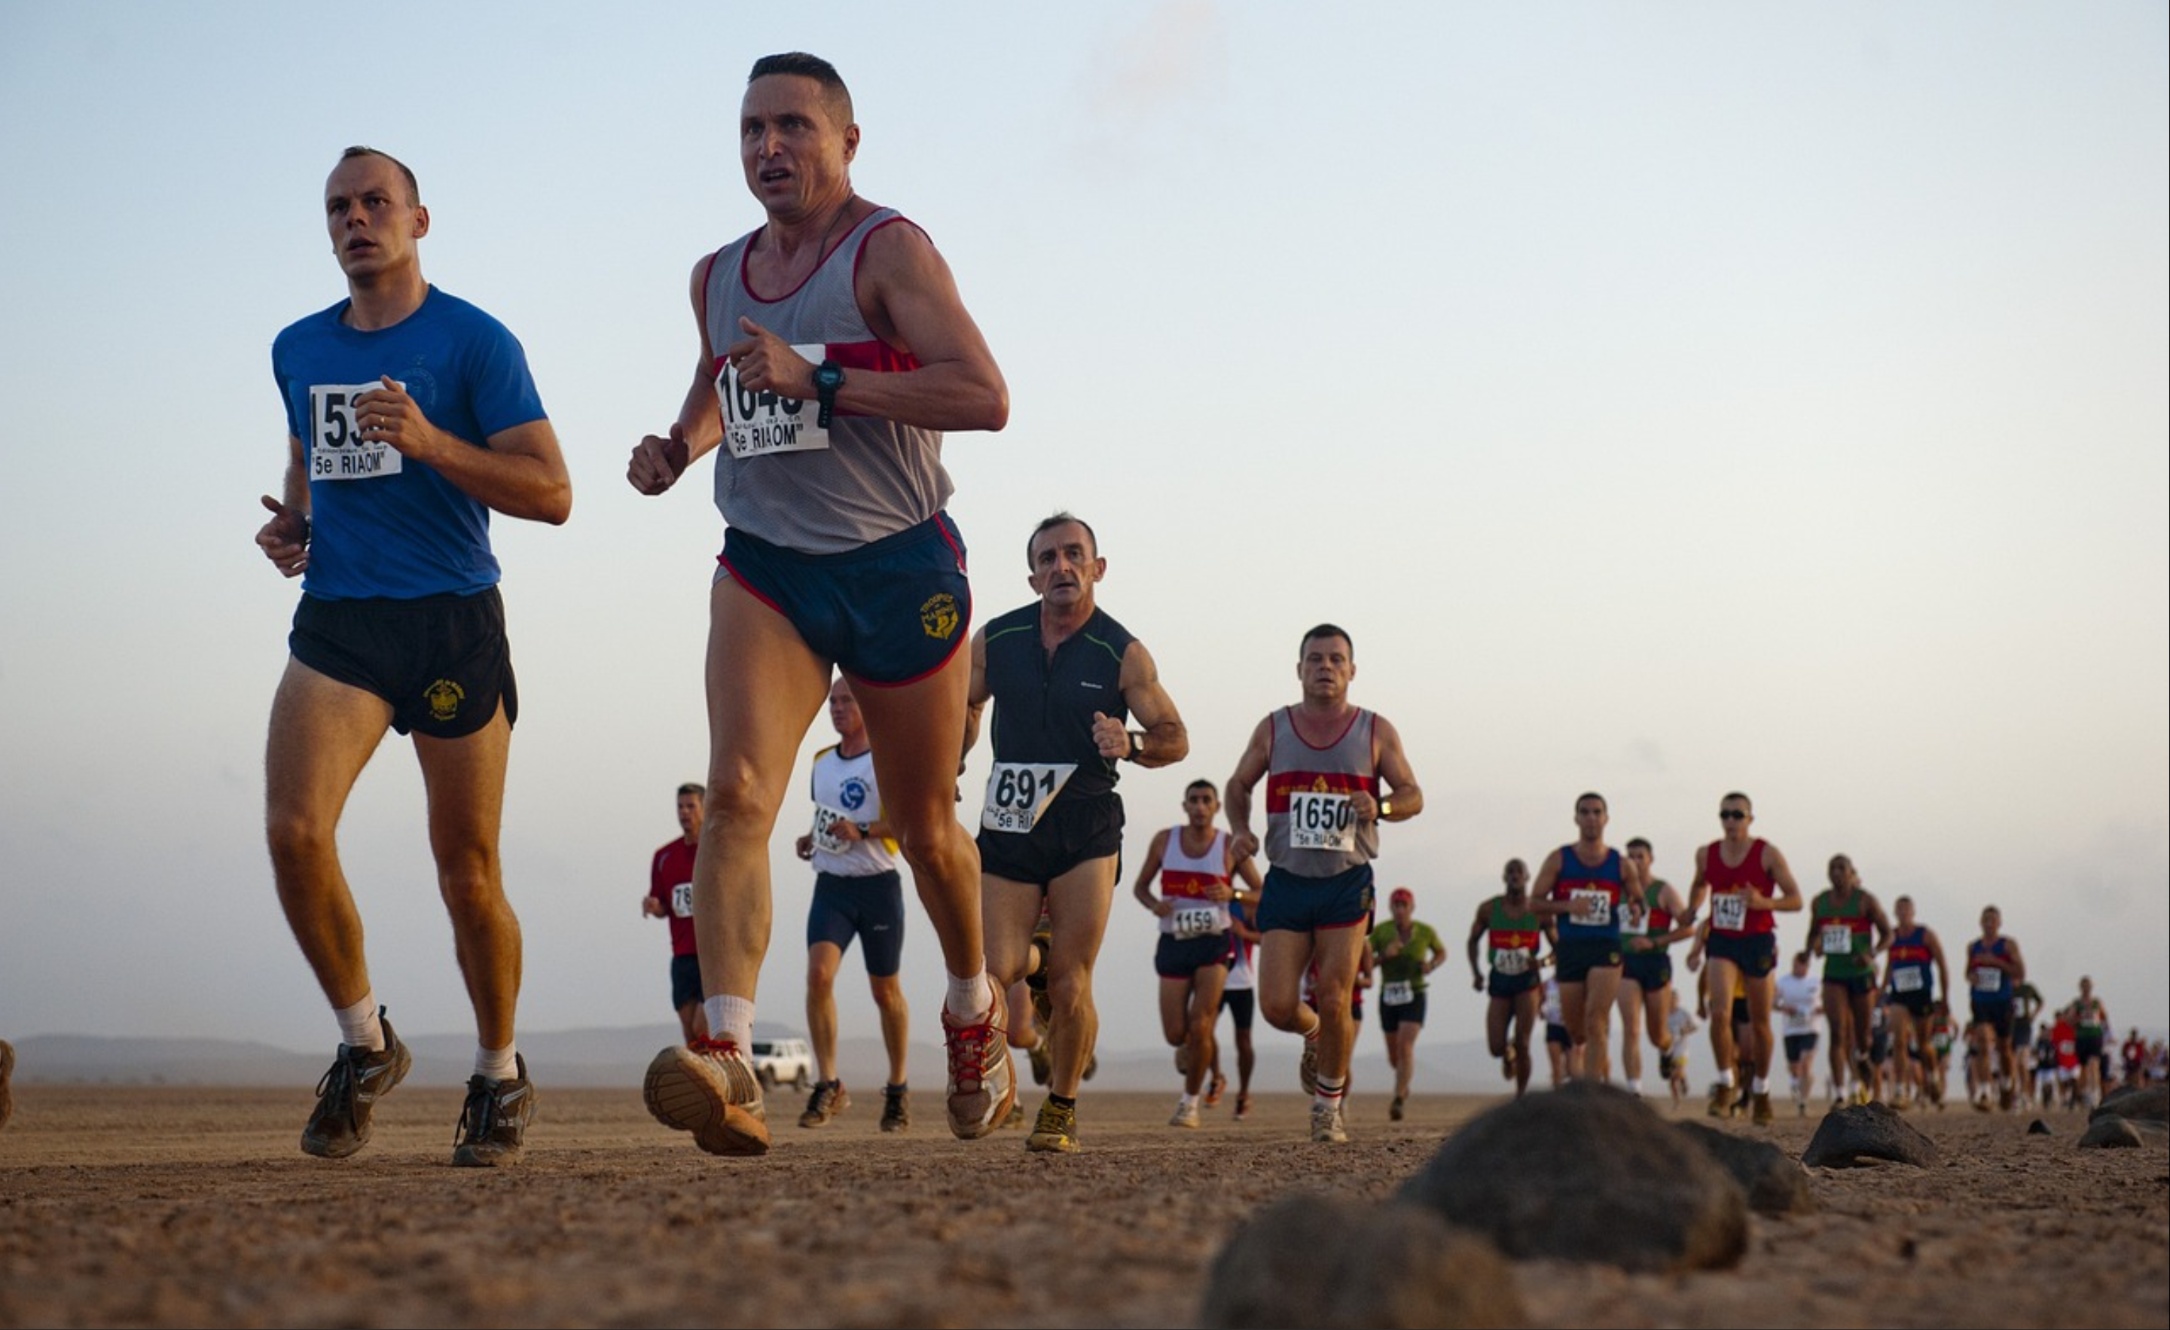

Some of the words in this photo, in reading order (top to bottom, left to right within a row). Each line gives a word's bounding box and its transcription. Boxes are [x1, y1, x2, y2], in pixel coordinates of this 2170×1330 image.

[995, 768, 1056, 810] 691
[1293, 796, 1351, 832] 1650
[1176, 910, 1212, 932] 1159
